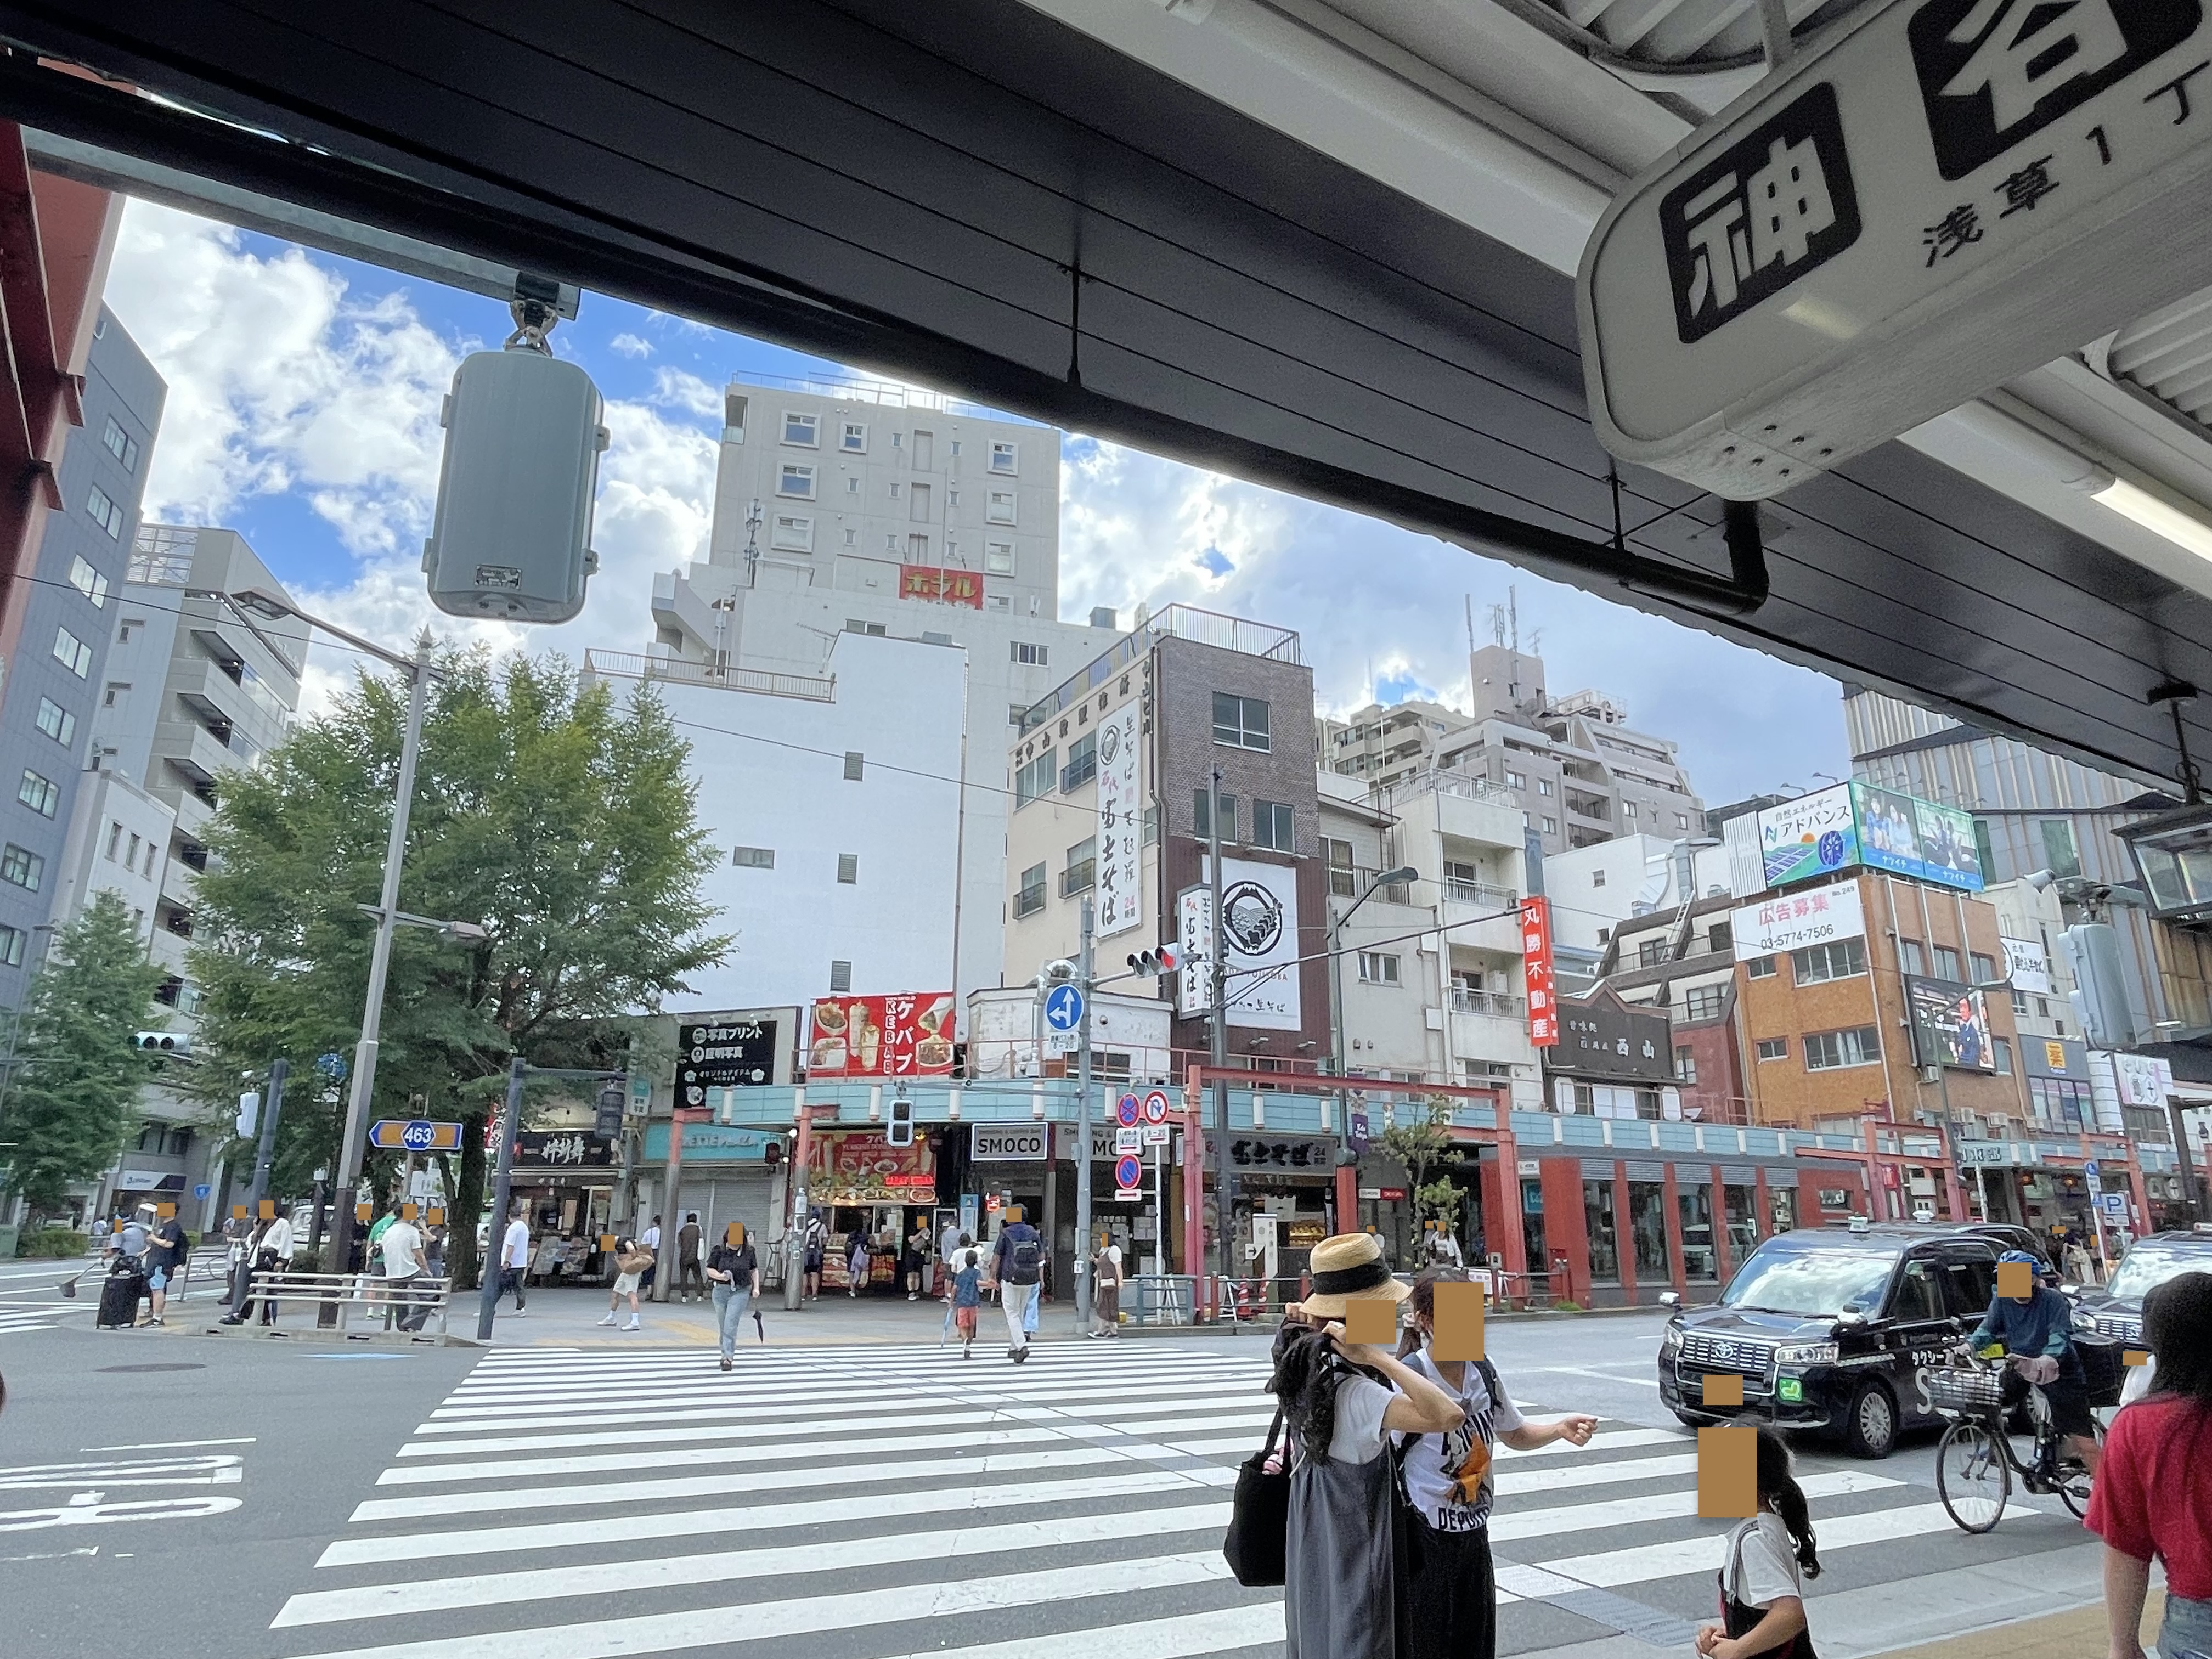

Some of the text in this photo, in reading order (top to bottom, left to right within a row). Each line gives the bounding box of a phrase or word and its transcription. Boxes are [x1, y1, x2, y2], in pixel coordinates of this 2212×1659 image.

[906, 572, 977, 598] ホテル
[1759, 893, 1829, 927] 広告募集
[1760, 924, 1833, 950] 03-5774-7506
[1523, 906, 1550, 1038] 丸勝不動産
[707, 1026, 763, 1041] 写真プリント
[895, 1001, 915, 1073] ケバブ
[405, 1127, 432, 1143] 463
[978, 1138, 1041, 1153] SMOCO
